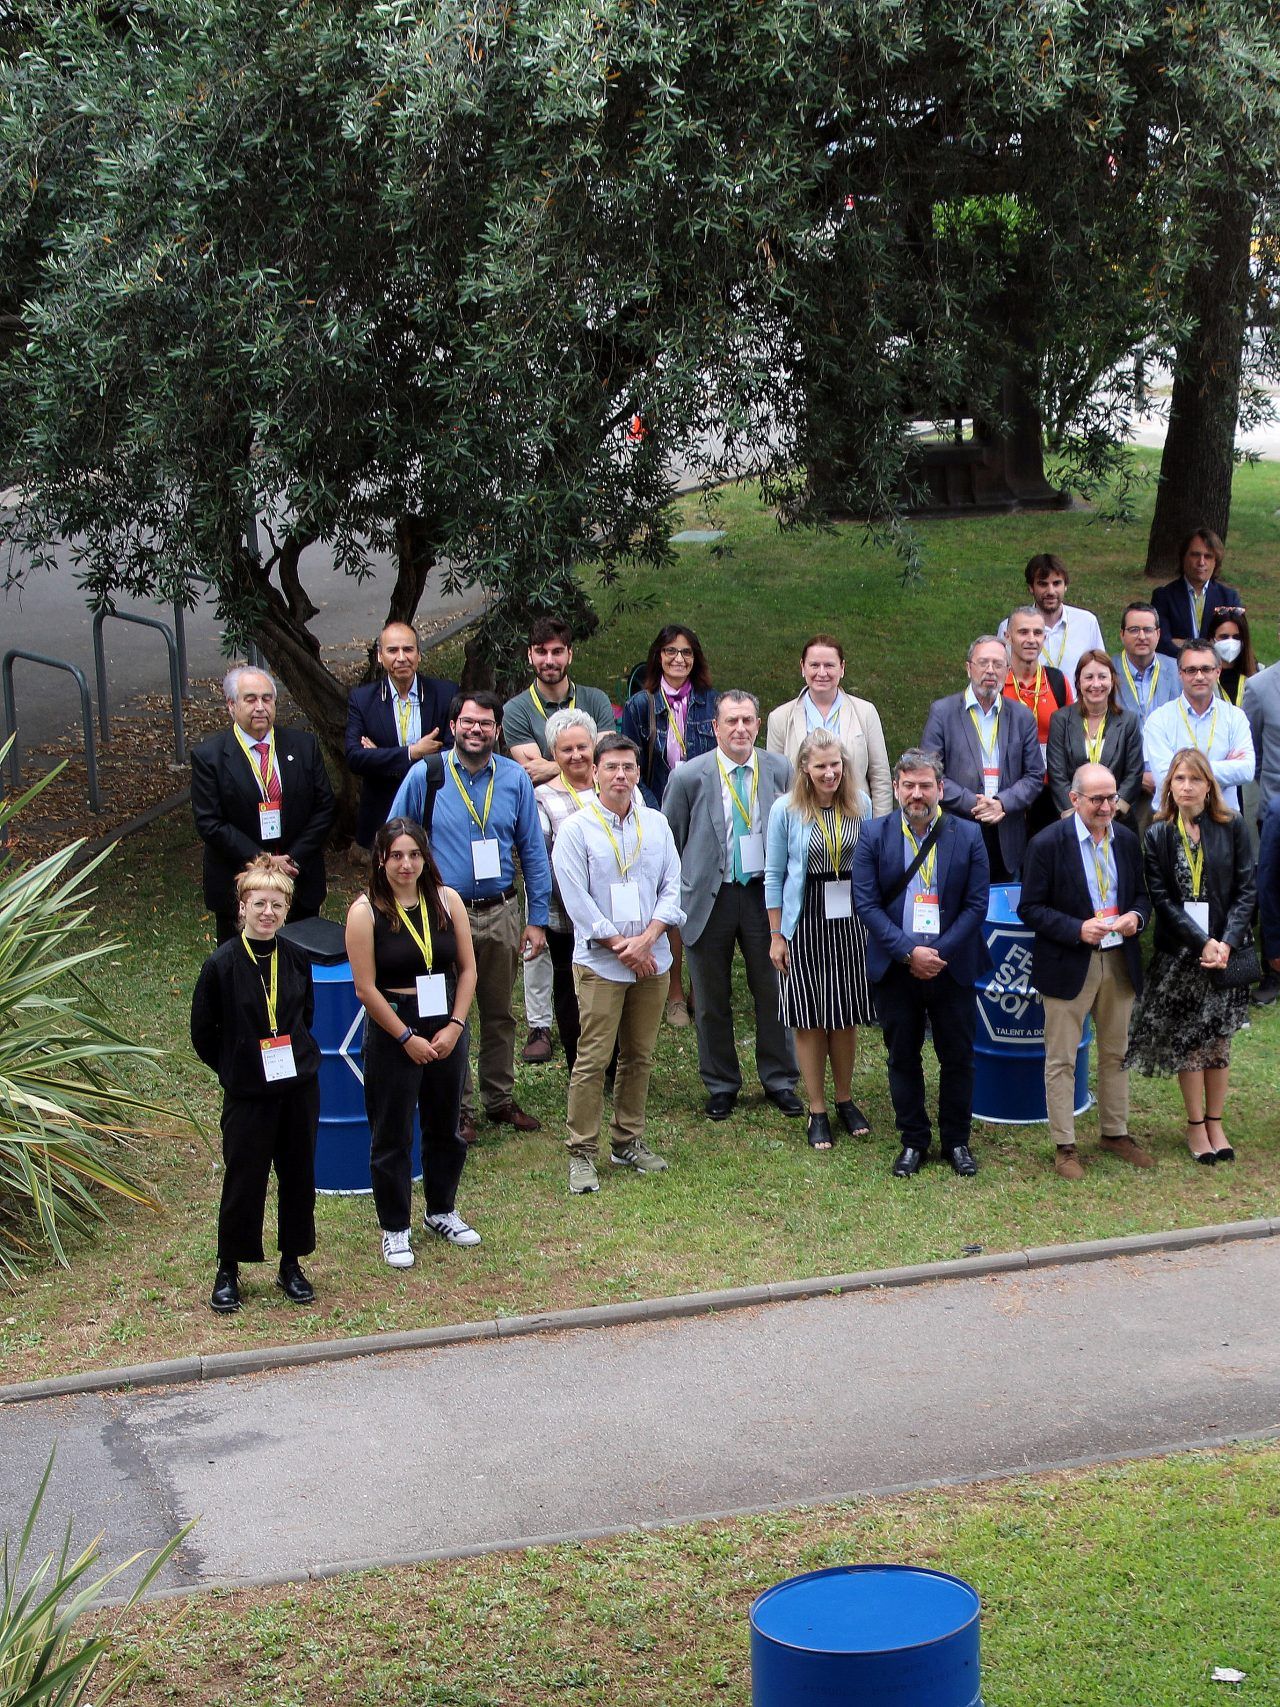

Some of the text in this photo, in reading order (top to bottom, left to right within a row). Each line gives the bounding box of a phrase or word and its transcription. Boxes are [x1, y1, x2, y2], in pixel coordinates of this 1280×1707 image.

[1004, 943, 1034, 975] FE
[984, 979, 1030, 1020] BOI
[996, 1027, 1024, 1036] TALENT
